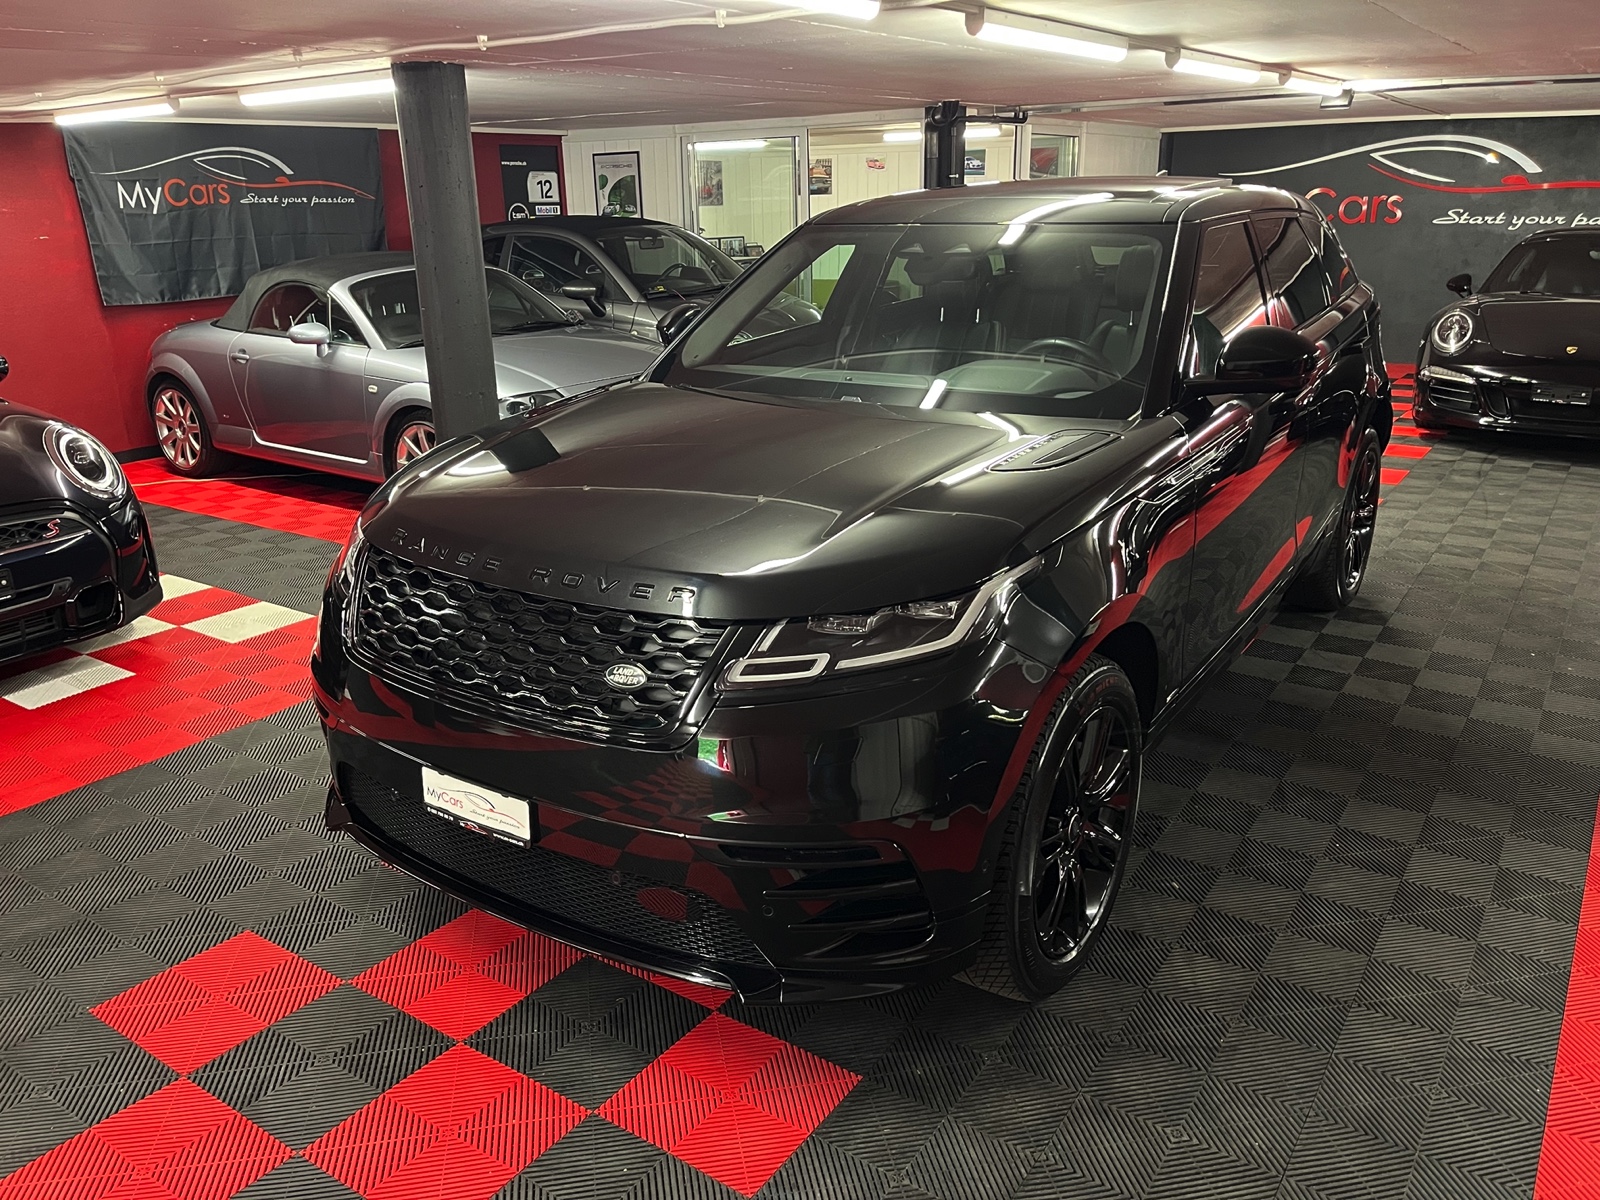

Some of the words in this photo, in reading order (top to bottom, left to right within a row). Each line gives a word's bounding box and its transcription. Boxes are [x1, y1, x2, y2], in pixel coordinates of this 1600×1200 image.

[117, 178, 231, 214] MyCars
[536, 179, 553, 199] 12
[240, 193, 279, 204] Start
[281, 196, 308, 207] your
[310, 195, 356, 207] passion
[1432, 208, 1506, 225] Start
[1508, 214, 1566, 230] your
[43, 519, 61, 538] S
[391, 527, 503, 573] RANGE
[529, 568, 697, 603] ROVER
[613, 666, 634, 676] LAND
[613, 674, 639, 685] ROVER
[427, 787, 464, 809] MyCars
